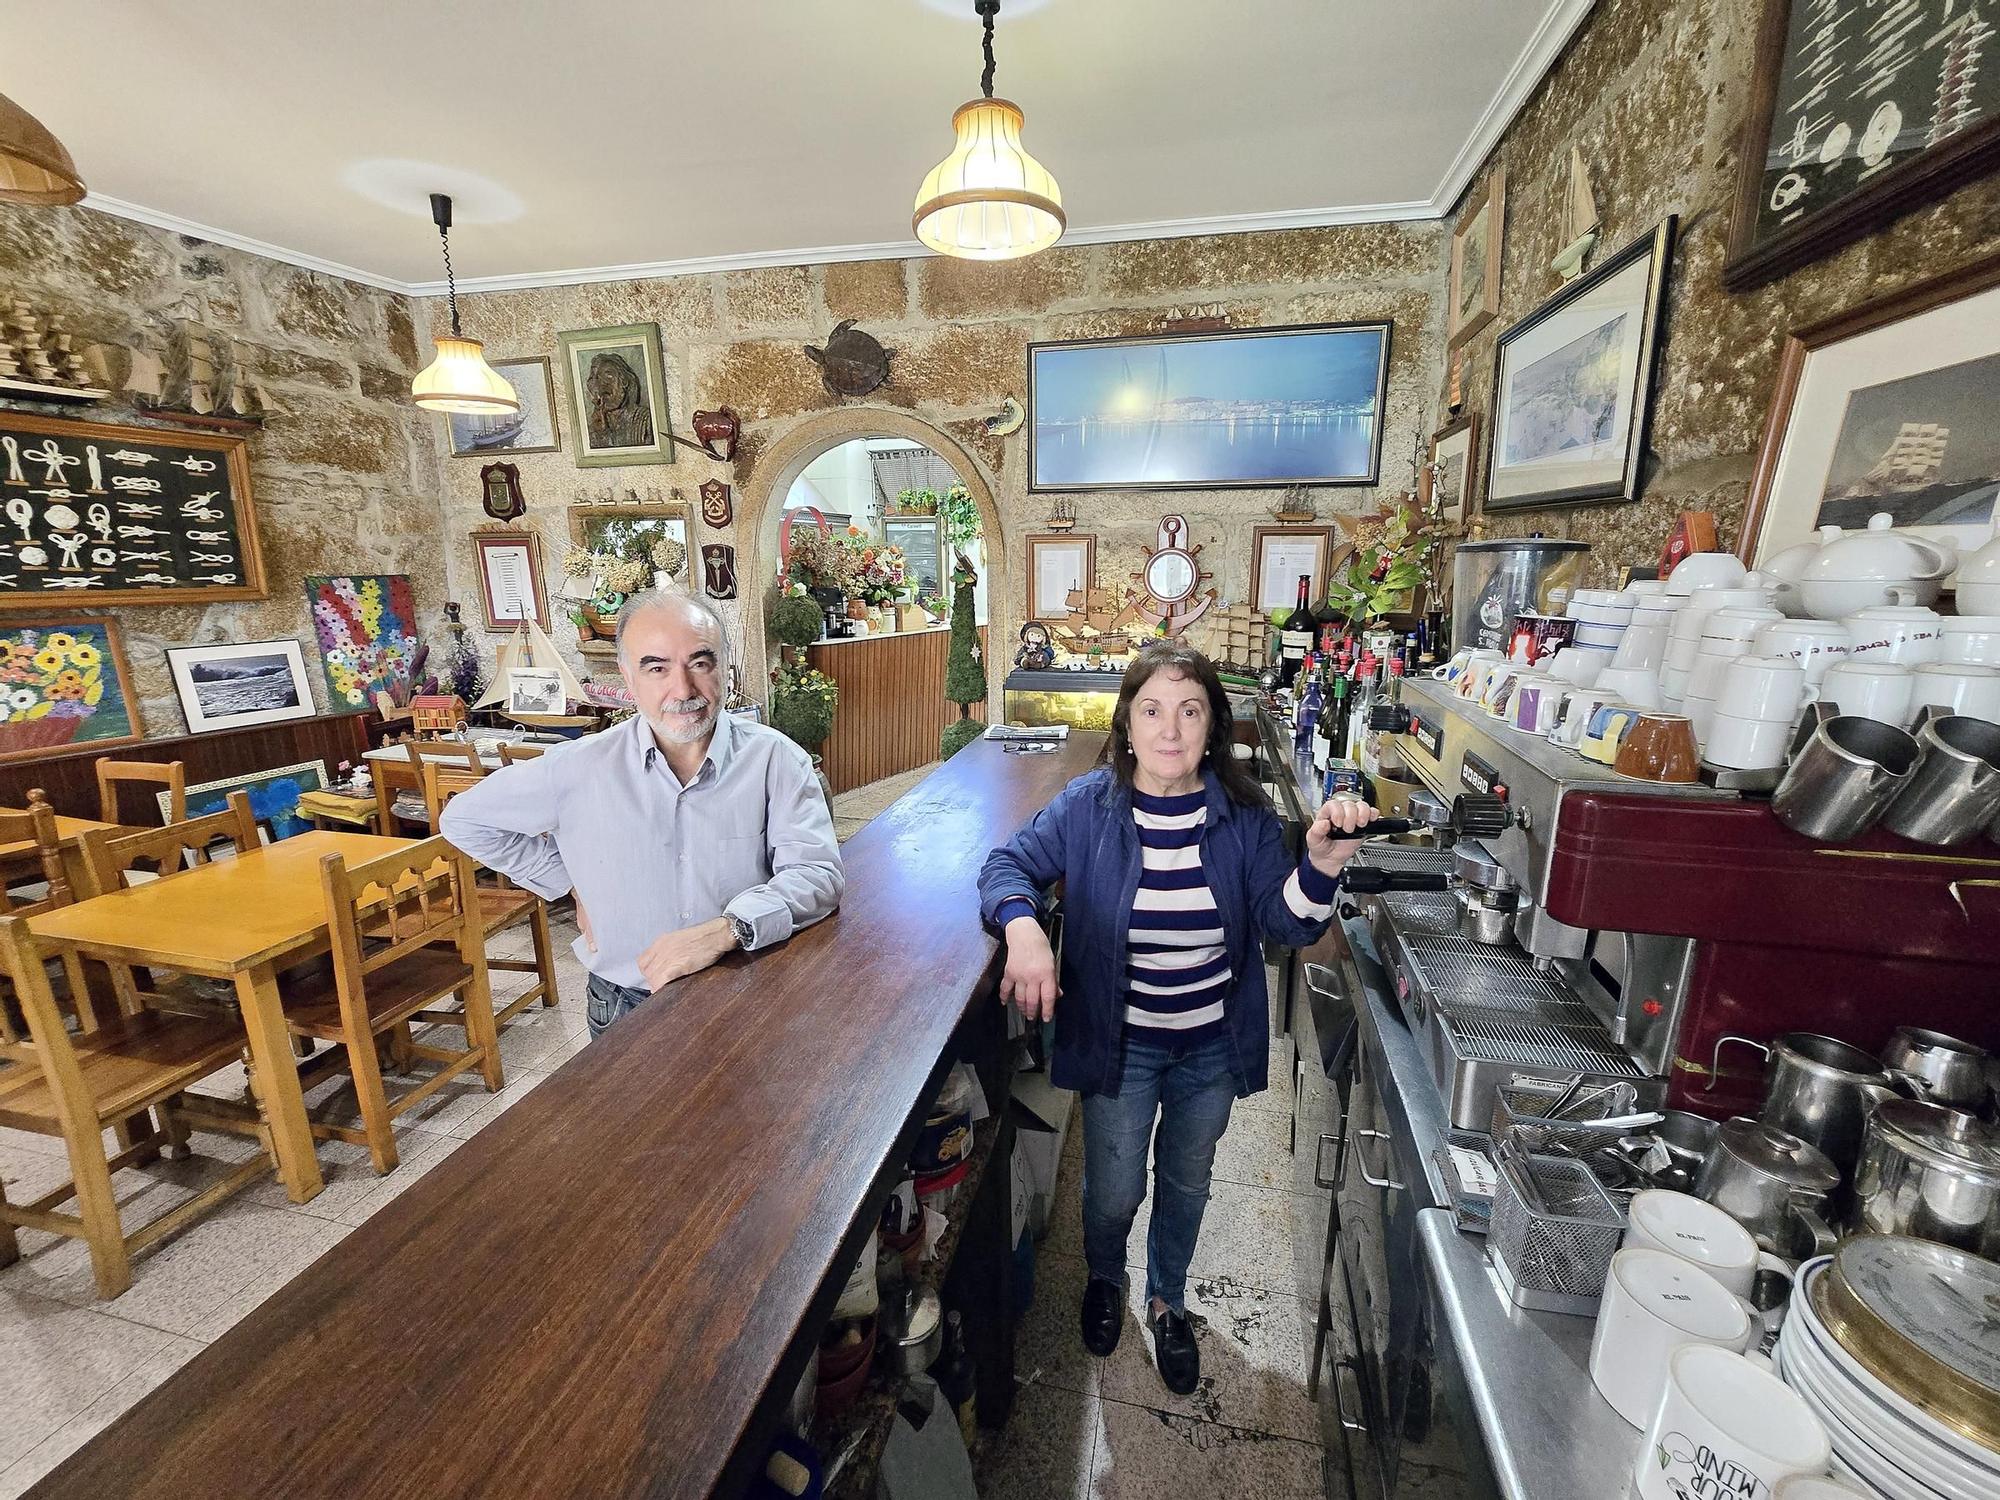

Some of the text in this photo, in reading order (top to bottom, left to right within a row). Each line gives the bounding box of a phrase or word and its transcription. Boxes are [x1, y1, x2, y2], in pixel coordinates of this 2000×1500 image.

[1853, 640, 1892, 653] tener
[1528, 1081, 1568, 1090] FABRICANT
[1697, 1445, 1758, 1498] MIND
[1691, 1473, 1743, 1500] OUR
